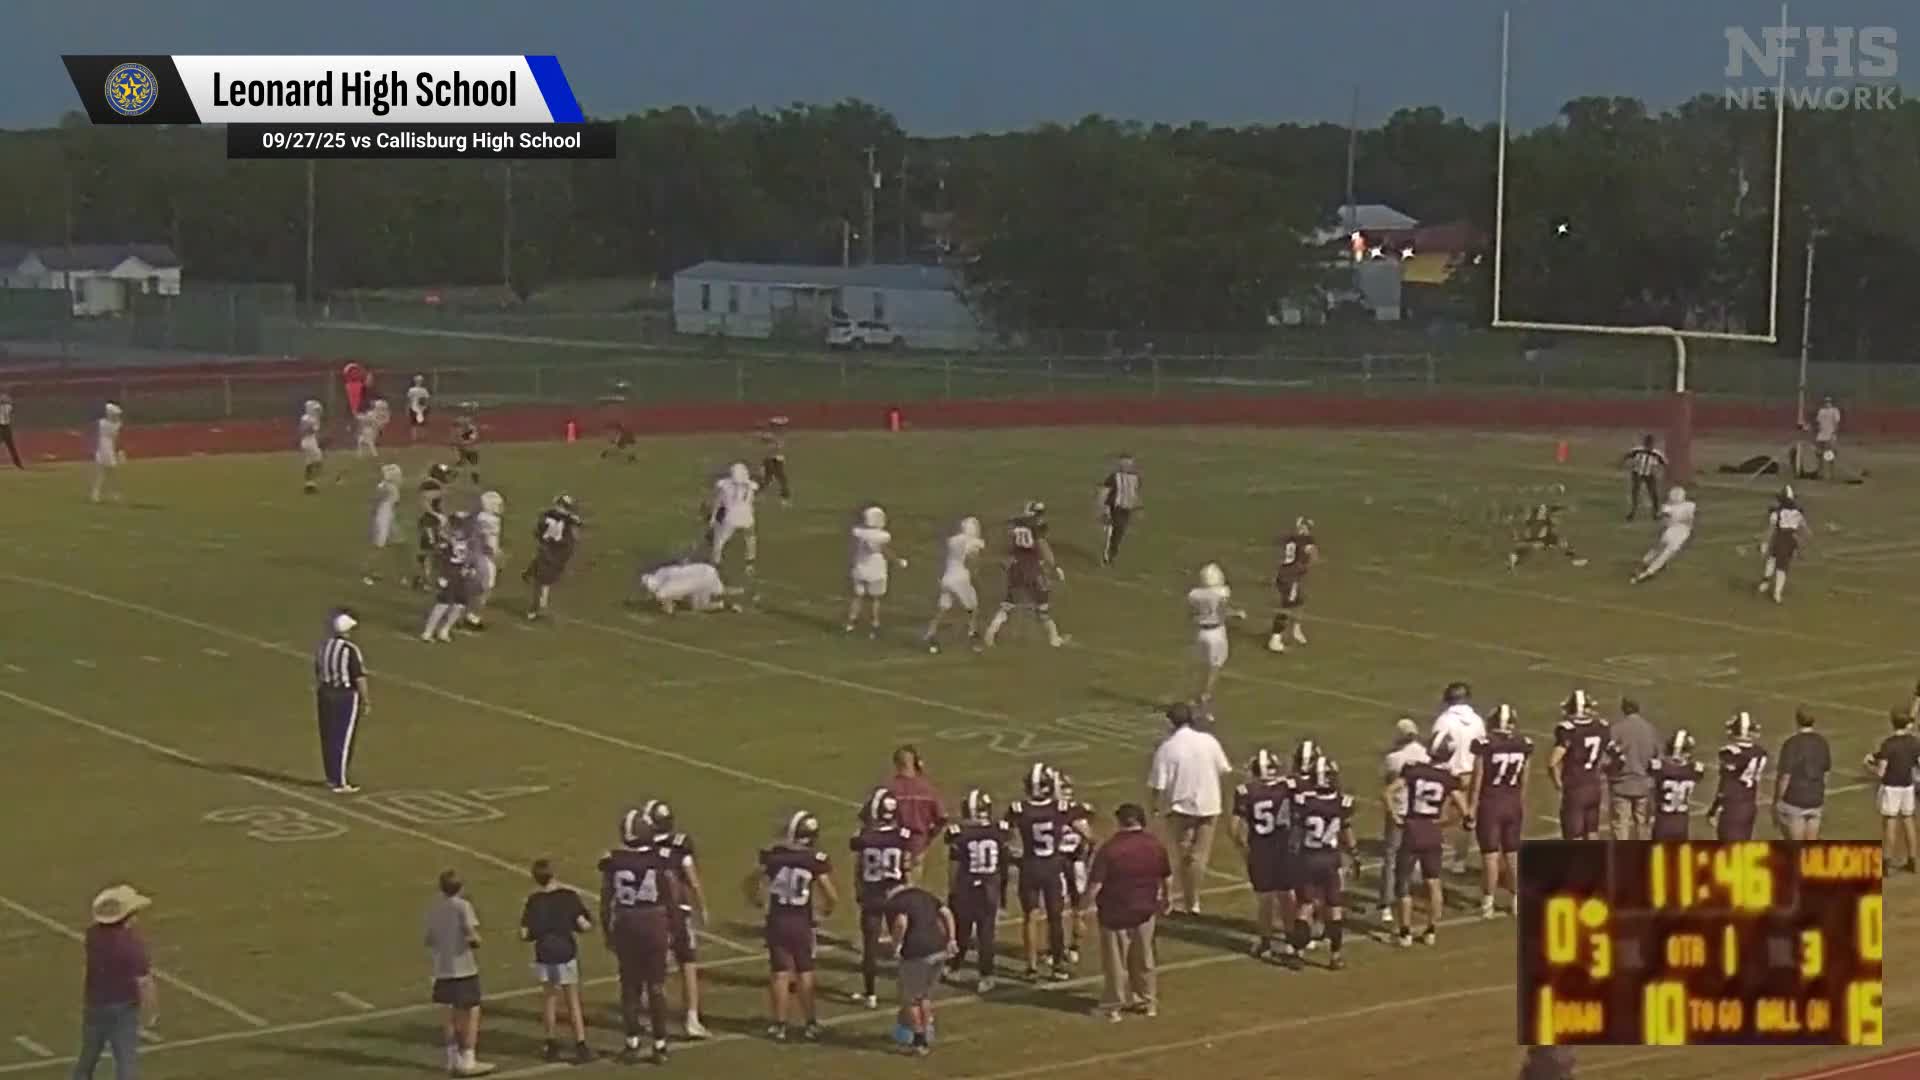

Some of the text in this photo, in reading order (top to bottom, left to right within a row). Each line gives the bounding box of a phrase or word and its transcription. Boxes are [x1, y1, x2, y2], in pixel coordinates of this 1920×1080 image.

[1491, 752, 1525, 786] 77
[1584, 736, 1601, 769] 7
[1253, 799, 1291, 835] 54
[1304, 815, 1341, 849] 24
[967, 839, 999, 874] 10
[1031, 821, 1054, 857] 5
[614, 868, 658, 906] 64
[770, 865, 813, 906] 40
[1651, 842, 1773, 909] 11:46
[1546, 897, 1578, 963] 0
[1588, 931, 1612, 979] 3
[1724, 923, 1737, 977] 1
[1801, 930, 1823, 979] 3
[1645, 982, 1686, 1045] 10
